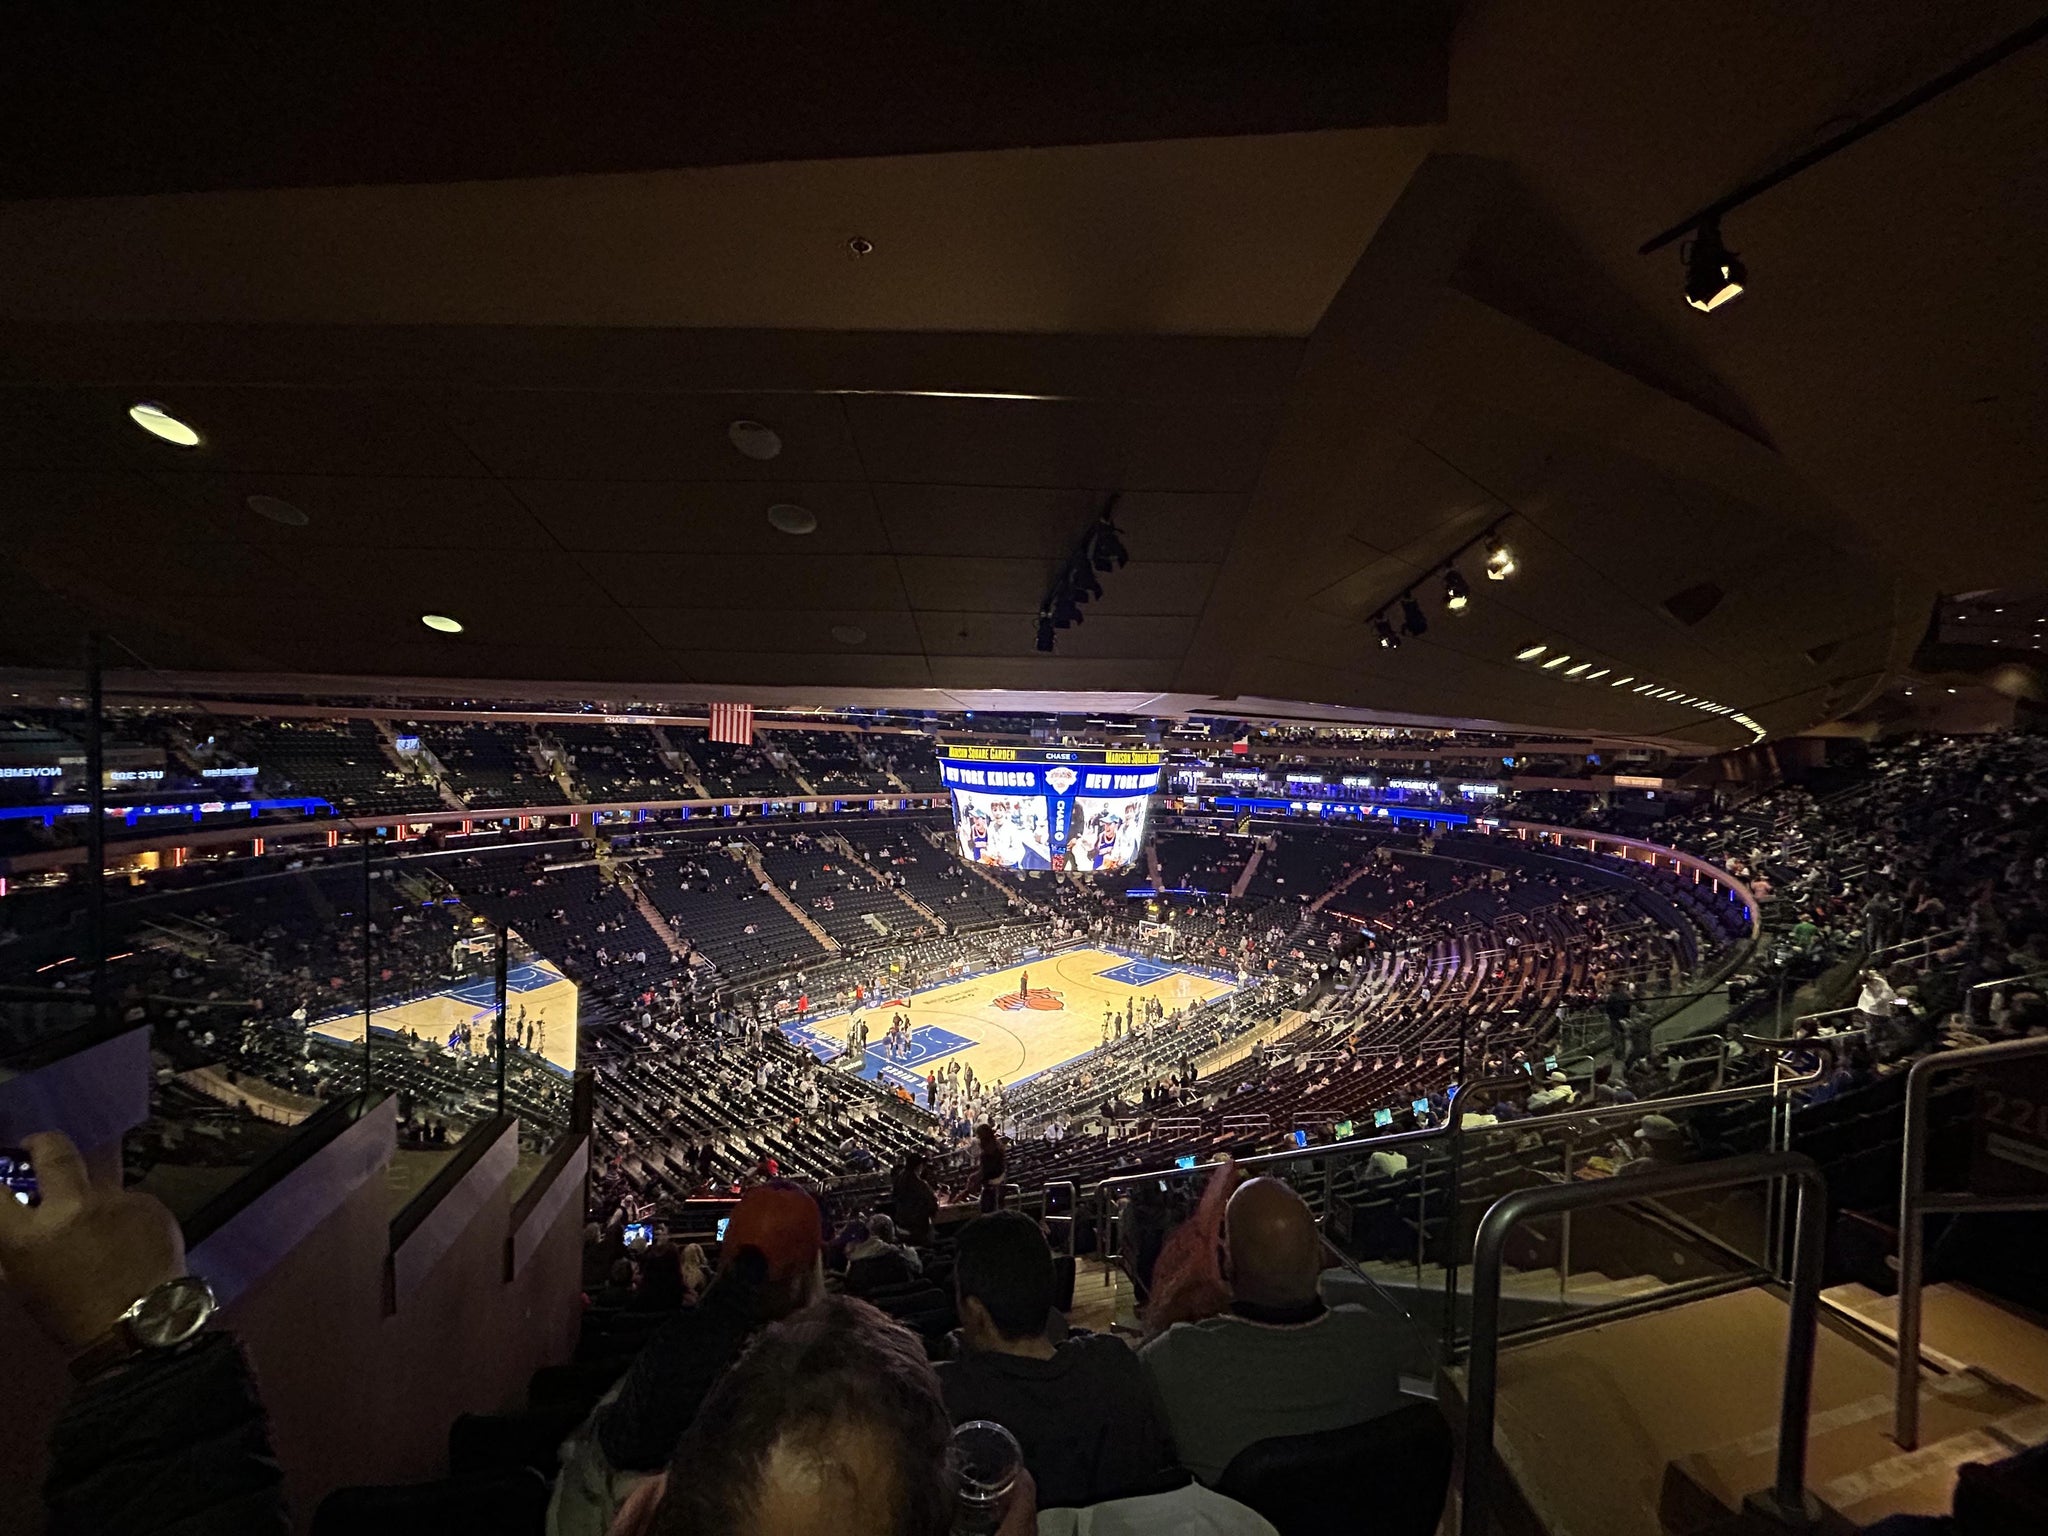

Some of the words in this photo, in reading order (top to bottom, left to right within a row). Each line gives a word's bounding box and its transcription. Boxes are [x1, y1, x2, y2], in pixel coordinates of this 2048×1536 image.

[990, 748, 1016, 760] GARDEN
[1105, 751, 1131, 764] MADISON
[959, 769, 986, 786] YORK
[986, 771, 1035, 787] KNICKS
[1085, 773, 1112, 789] NEW
[1113, 774, 1139, 789] YORK
[1222, 772, 1258, 781] NOVEMBER
[1389, 780, 1428, 790] NOVEMBER
[882, 1065, 919, 1083] KNICKS
